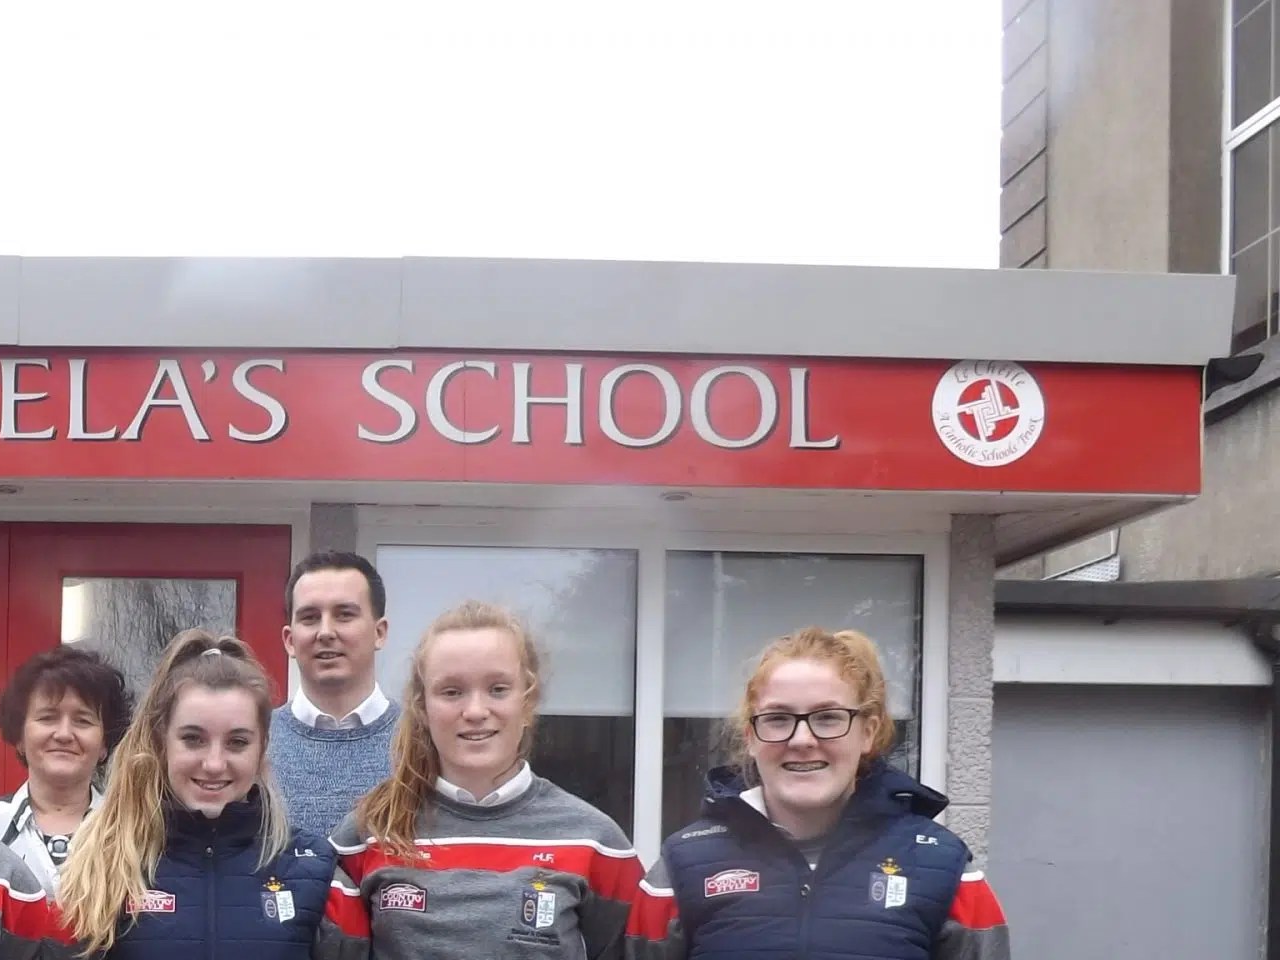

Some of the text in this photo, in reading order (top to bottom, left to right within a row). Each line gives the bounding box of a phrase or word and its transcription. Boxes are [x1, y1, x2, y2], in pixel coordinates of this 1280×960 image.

[357, 358, 841, 451] SCHOOL
[939, 424, 978, 458] Catholic
[978, 441, 1018, 462] Schools
[1017, 417, 1043, 446] Trust
[382, 892, 424, 904] COUNTRY
[387, 899, 414, 908] STYLE
